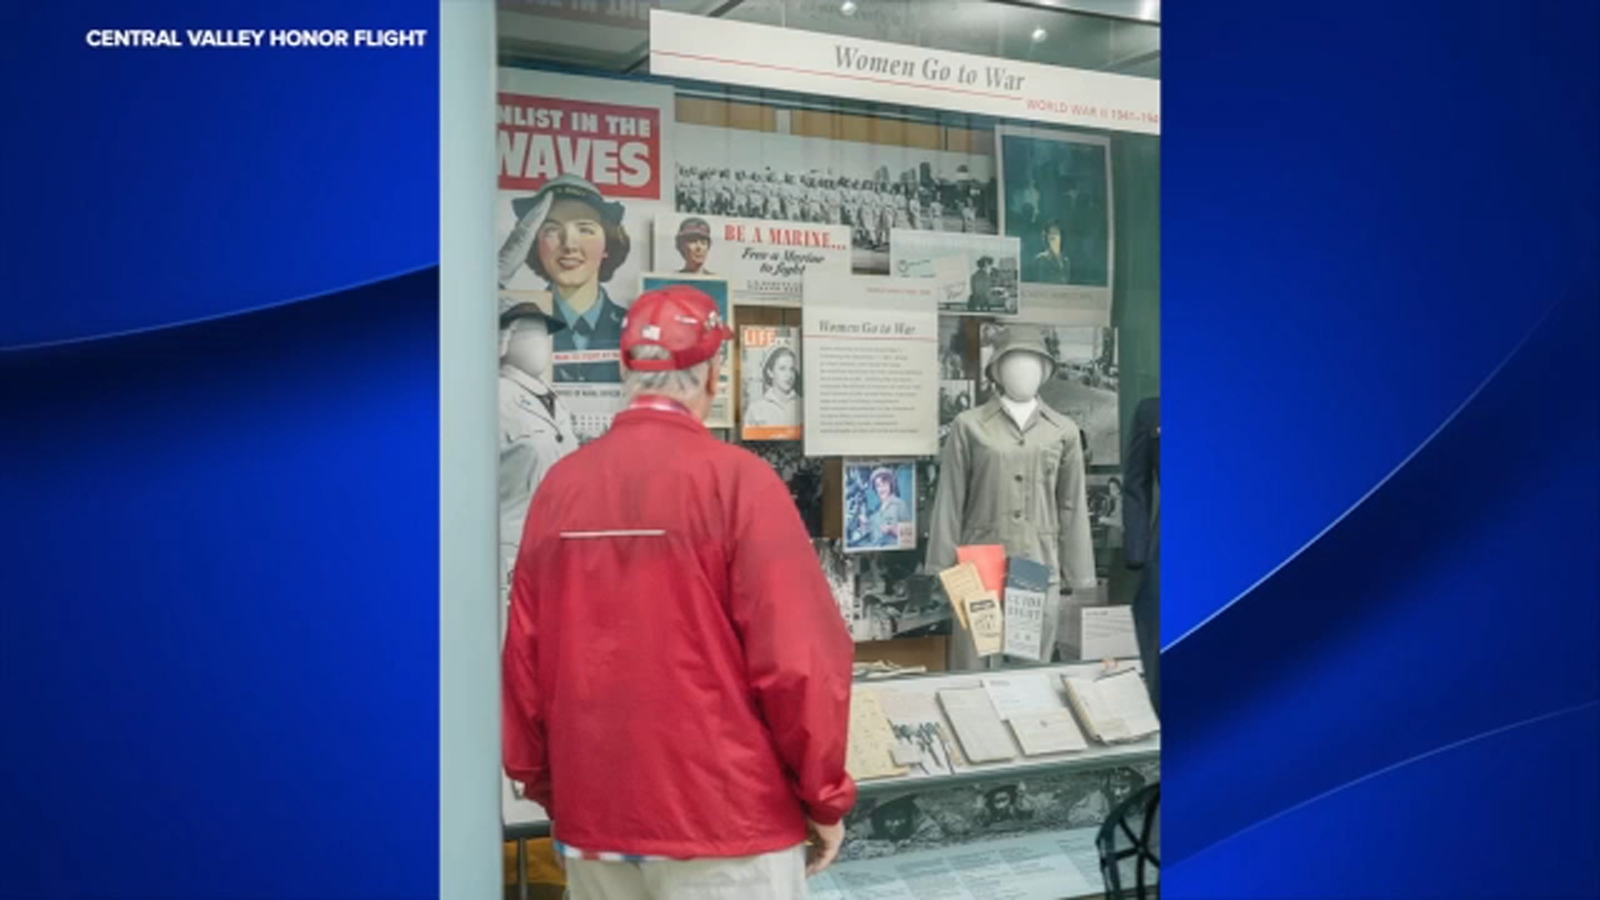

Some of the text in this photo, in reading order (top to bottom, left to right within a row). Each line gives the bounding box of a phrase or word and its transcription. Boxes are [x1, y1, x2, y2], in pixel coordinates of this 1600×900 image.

[834, 45, 1025, 91] Women Go to War
[1026, 99, 1067, 113] WORLD
[1071, 104, 1096, 116] WAR
[571, 112, 598, 132] IN
[605, 115, 651, 137] THE
[496, 130, 651, 187] WAVES
[724, 224, 746, 243] BE
[753, 227, 762, 243] A
[741, 247, 825, 263] Free a Marine
[759, 262, 806, 277] to fight
[819, 320, 916, 335] Women Go to War
[743, 329, 774, 347] LIFE
